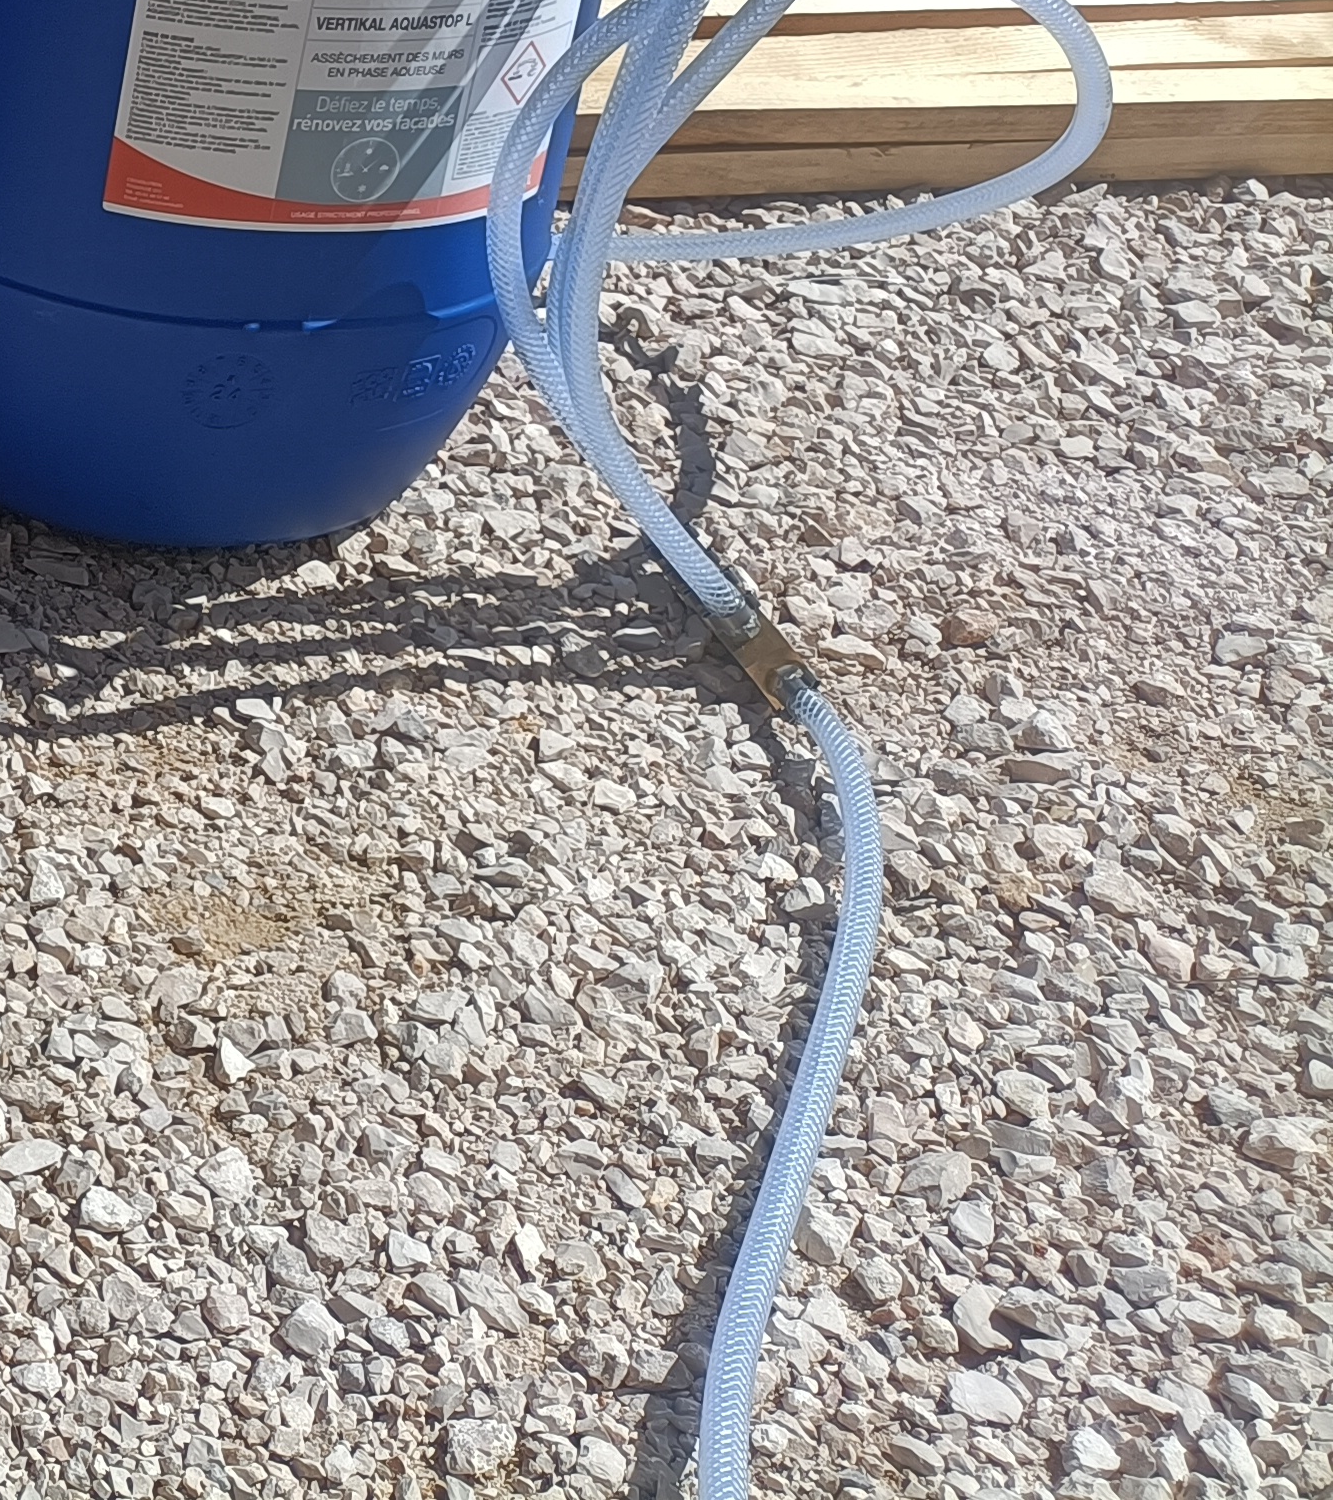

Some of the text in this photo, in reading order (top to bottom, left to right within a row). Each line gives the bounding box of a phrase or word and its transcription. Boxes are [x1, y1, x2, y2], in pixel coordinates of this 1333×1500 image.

[316, 13, 473, 31] VERTIKAL AQUASTOP L
[405, 51, 430, 63] DES
[431, 48, 465, 61] MURS
[327, 64, 447, 78] EN PHASE AQUEUSE
[316, 95, 441, 114] Défiez le temps,
[292, 112, 455, 133] rénovez vos façades
